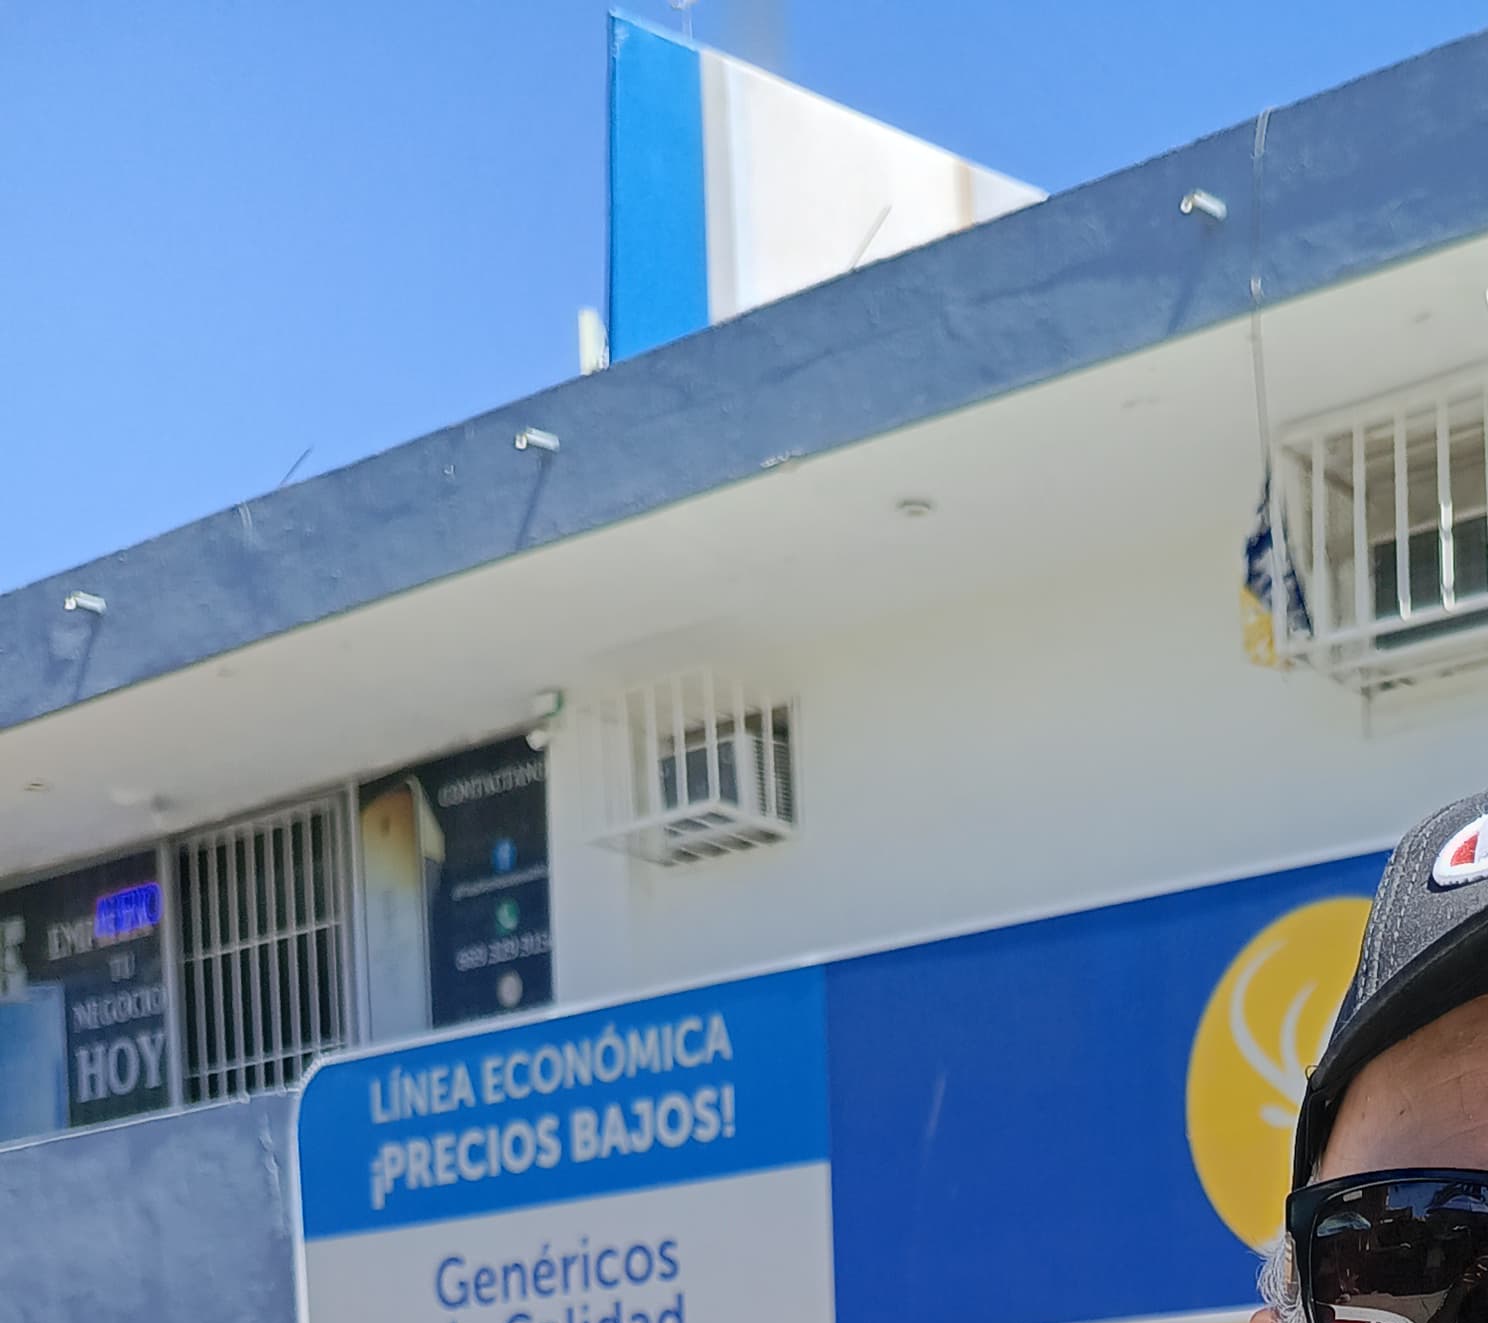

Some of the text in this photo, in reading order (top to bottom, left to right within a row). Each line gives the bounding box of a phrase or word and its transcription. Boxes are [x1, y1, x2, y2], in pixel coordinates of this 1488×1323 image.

[75, 1032, 167, 1104] HOY
[370, 1013, 734, 1124] LÍNEA ECONÓMICA
[370, 1083, 736, 1211] ¡PRECIOS BAJOS!
[434, 1237, 681, 1310] Genéricos
